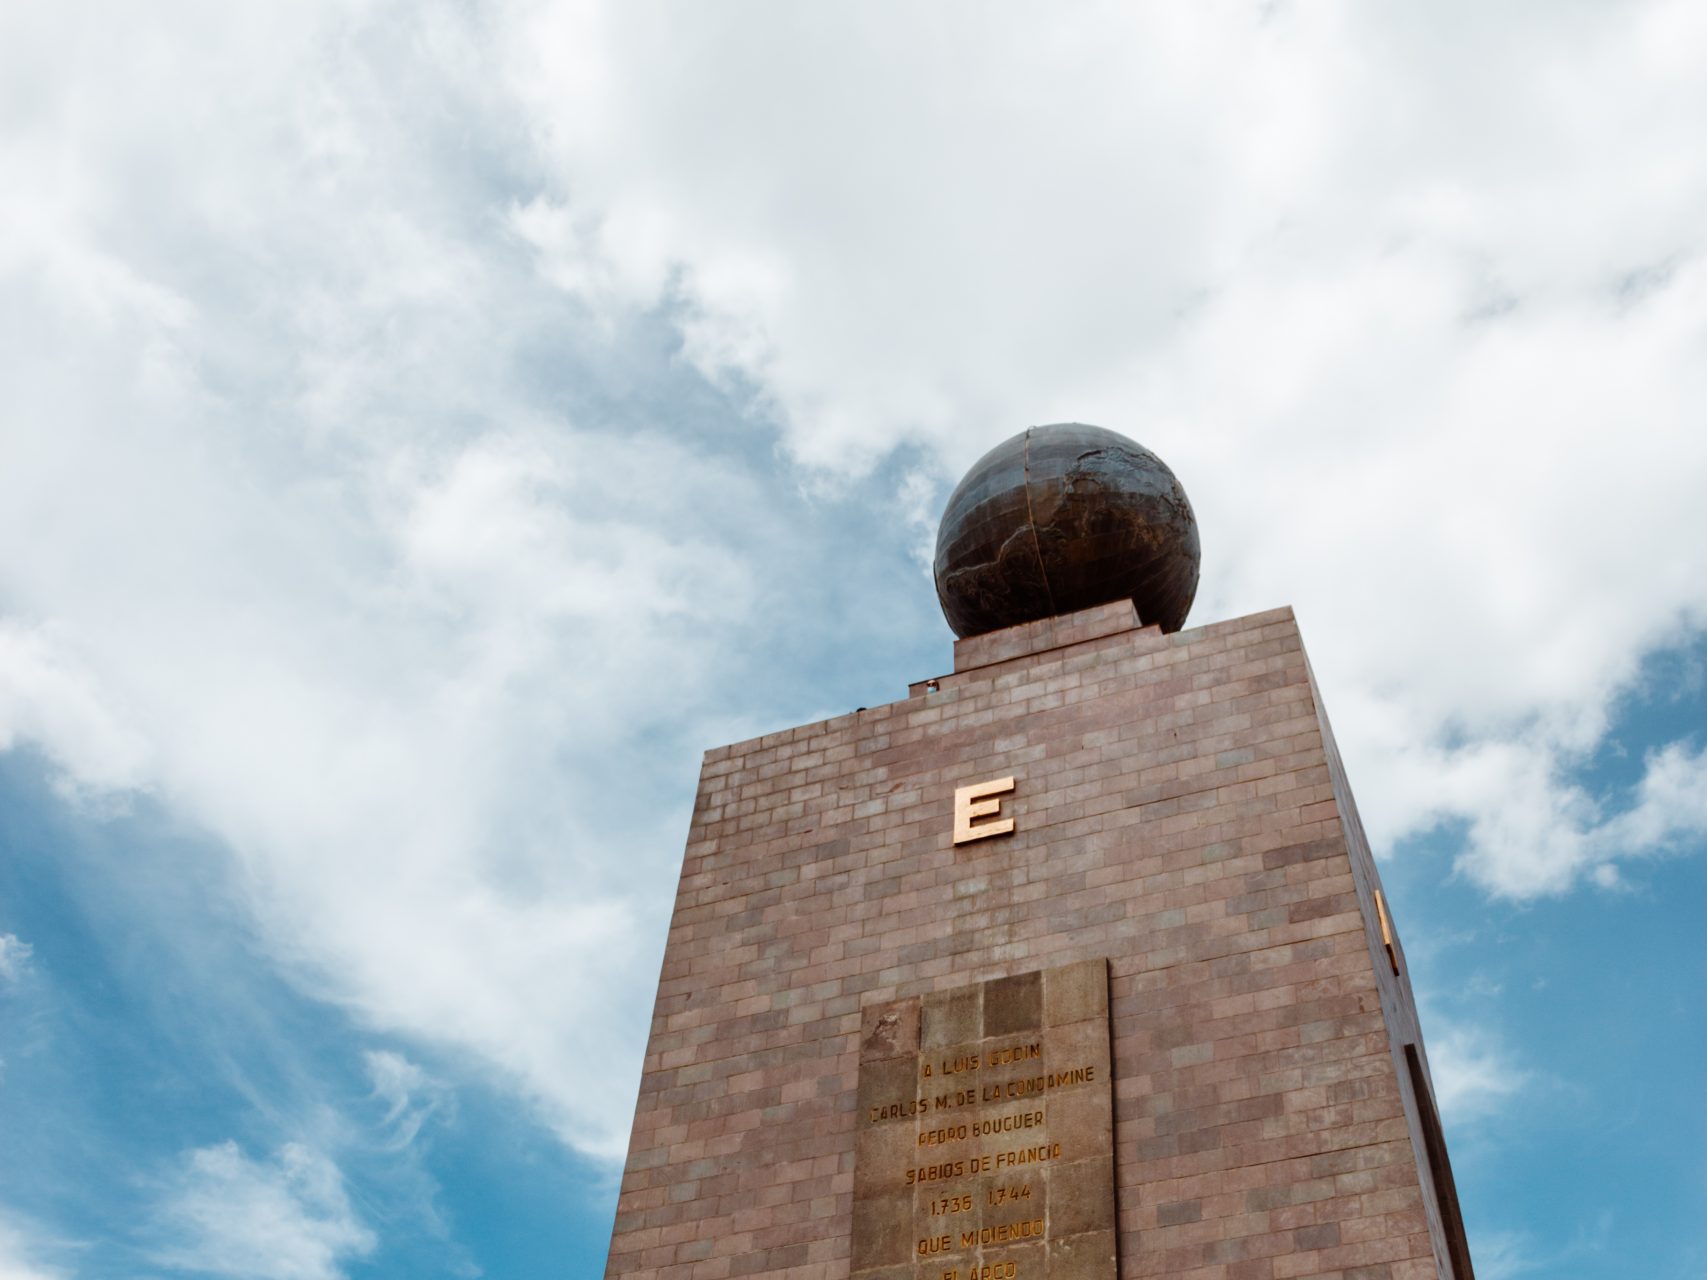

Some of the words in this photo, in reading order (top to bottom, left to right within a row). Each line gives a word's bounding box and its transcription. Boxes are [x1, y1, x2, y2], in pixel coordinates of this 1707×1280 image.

[953, 776, 1015, 846] E
[924, 1064, 932, 1078] A
[942, 1055, 979, 1075] LUIS
[988, 1043, 1040, 1067] GODIN
[869, 1099, 928, 1123] CARLOS
[935, 1095, 951, 1110] M.
[956, 1089, 975, 1106] DE
[982, 1085, 1000, 1102] LA
[1006, 1066, 1095, 1098] CONDAMINE
[918, 1125, 967, 1148] PEDRO
[972, 1111, 1043, 1137] BOUGUER
[905, 1160, 964, 1185] SABIOS
[970, 1156, 991, 1174] DE
[996, 1143, 1061, 1169] FRANCIA
[931, 1195, 972, 1216] 1.736
[988, 1184, 1031, 1206] 1.744
[917, 1235, 951, 1256] QUE
[961, 1219, 1045, 1247] MIDIENDO
